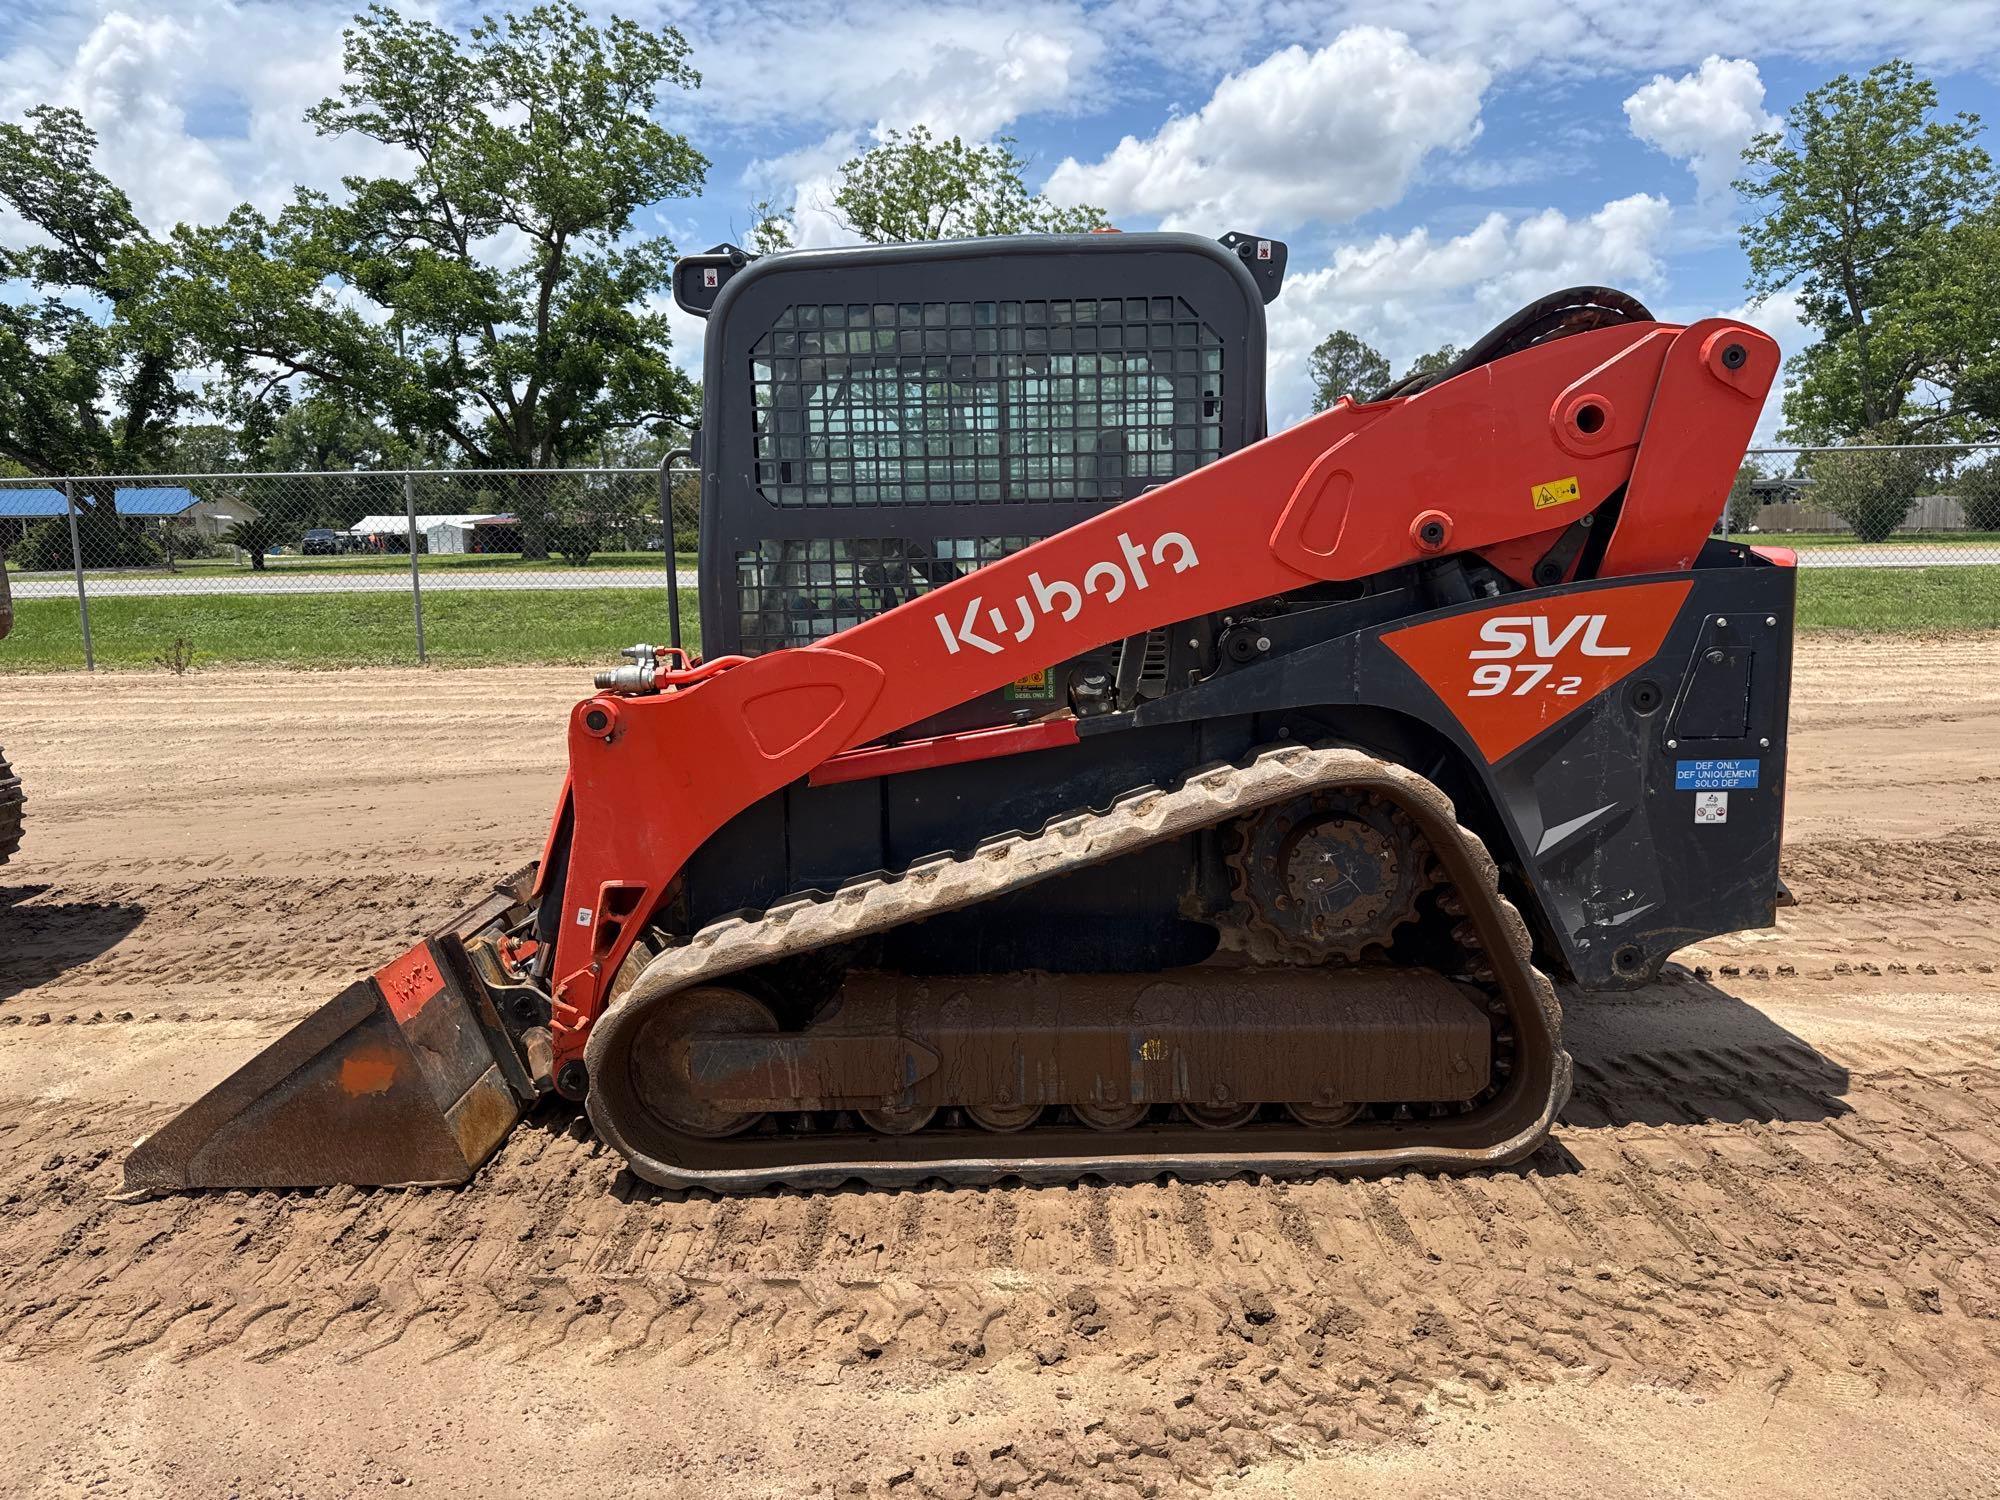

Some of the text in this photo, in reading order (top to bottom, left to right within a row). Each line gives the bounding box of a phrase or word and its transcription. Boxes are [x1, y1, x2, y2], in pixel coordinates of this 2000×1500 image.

[934, 532, 1200, 655] Kubota
[1468, 614, 1632, 660] SVL
[1467, 663, 1583, 697] 97-2
[1677, 769, 1758, 779] DEF UNIQUEMENT
[1695, 761, 1741, 770] DEF ONLY
[1694, 778, 1740, 788] SOLO DEF
